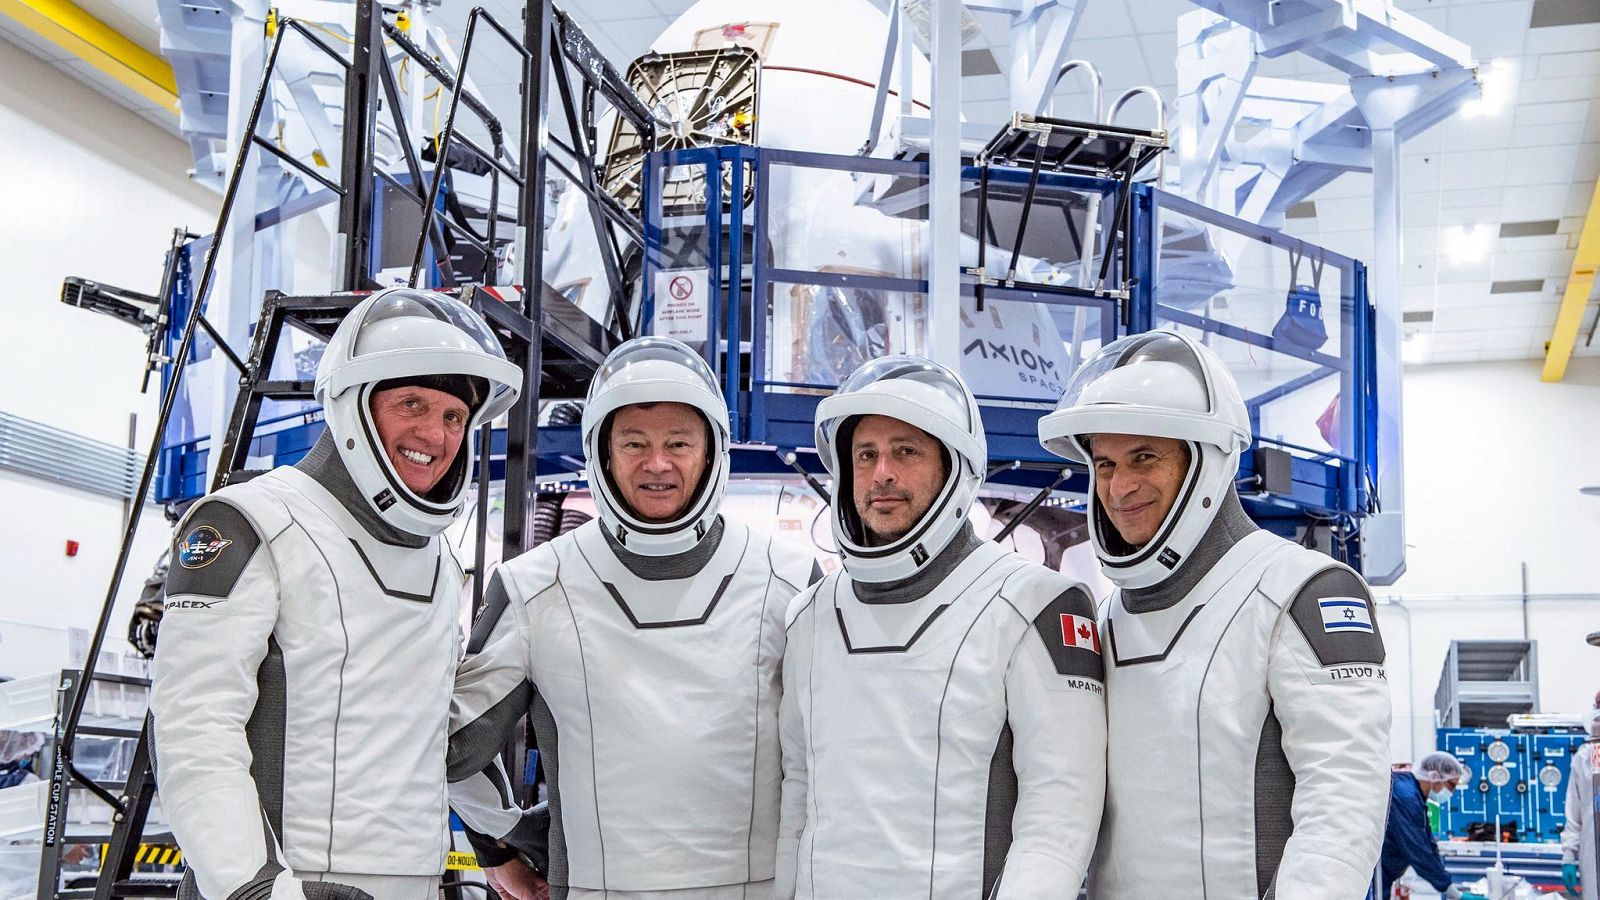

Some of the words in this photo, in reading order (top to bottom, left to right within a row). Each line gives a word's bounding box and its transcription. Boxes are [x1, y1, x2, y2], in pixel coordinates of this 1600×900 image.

[963, 338, 1060, 381] AXIOM
[164, 600, 226, 611] SPACEX
[1330, 667, 1373, 680] סטיבה
[52, 783, 61, 802] CUP
[47, 803, 58, 844] STATION
